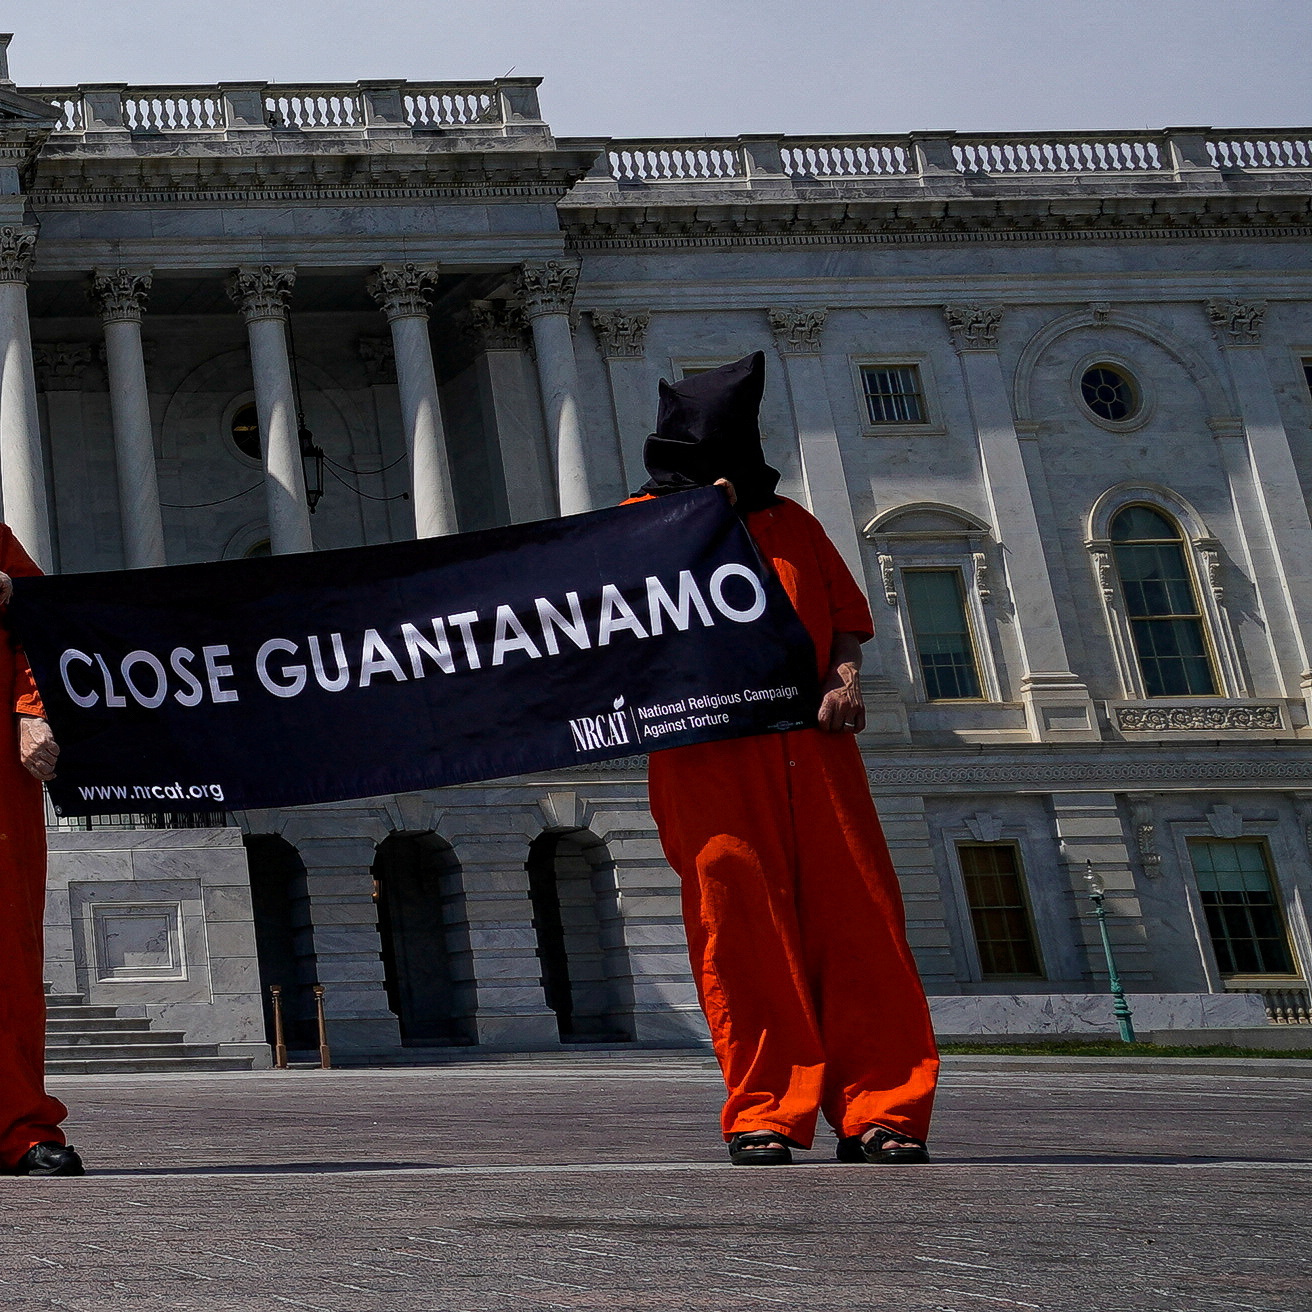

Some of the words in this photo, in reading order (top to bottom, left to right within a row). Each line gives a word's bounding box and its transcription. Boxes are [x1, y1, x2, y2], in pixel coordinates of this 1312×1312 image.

[59, 644, 239, 709] CLOSE
[256, 562, 767, 698] GUANTANAMO
[638, 699, 686, 720] National
[688, 693, 741, 709] Religious
[743, 685, 798, 701] Campaign
[568, 711, 630, 752] NRCAT
[644, 718, 687, 738] Against
[687, 713, 730, 728] Torture
[78, 781, 225, 802] www.nrcat.org
